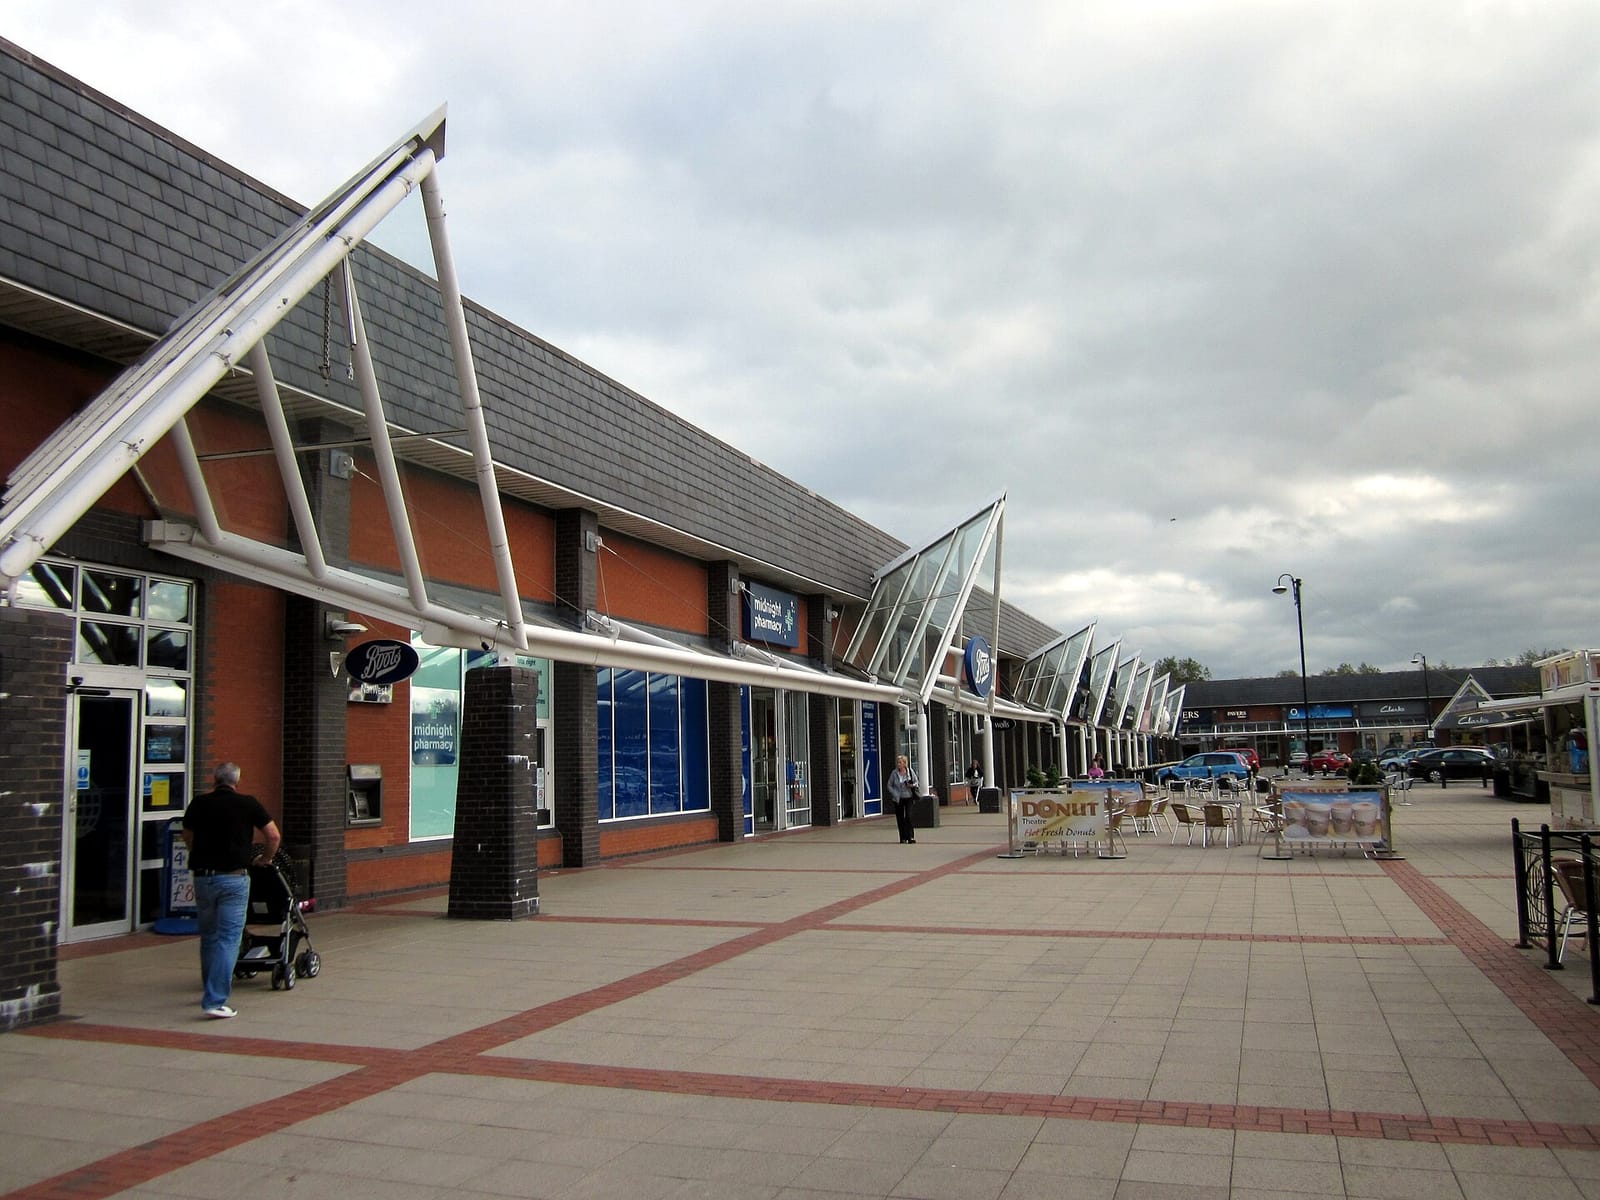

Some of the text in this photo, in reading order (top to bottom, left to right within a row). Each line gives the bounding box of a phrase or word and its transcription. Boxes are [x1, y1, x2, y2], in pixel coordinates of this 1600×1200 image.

[754, 597, 782, 618] midnight
[754, 614, 782, 635] pharmacy
[361, 644, 401, 679] Boots
[975, 648, 990, 684] Boots
[360, 683, 388, 696] NatWest
[1457, 716, 1489, 725] Clarks
[414, 723, 453, 739] midnight
[414, 738, 454, 752] pharmacy
[1021, 799, 1099, 819] DONUT
[1024, 827, 1096, 837] Hot Fresh Donuts
